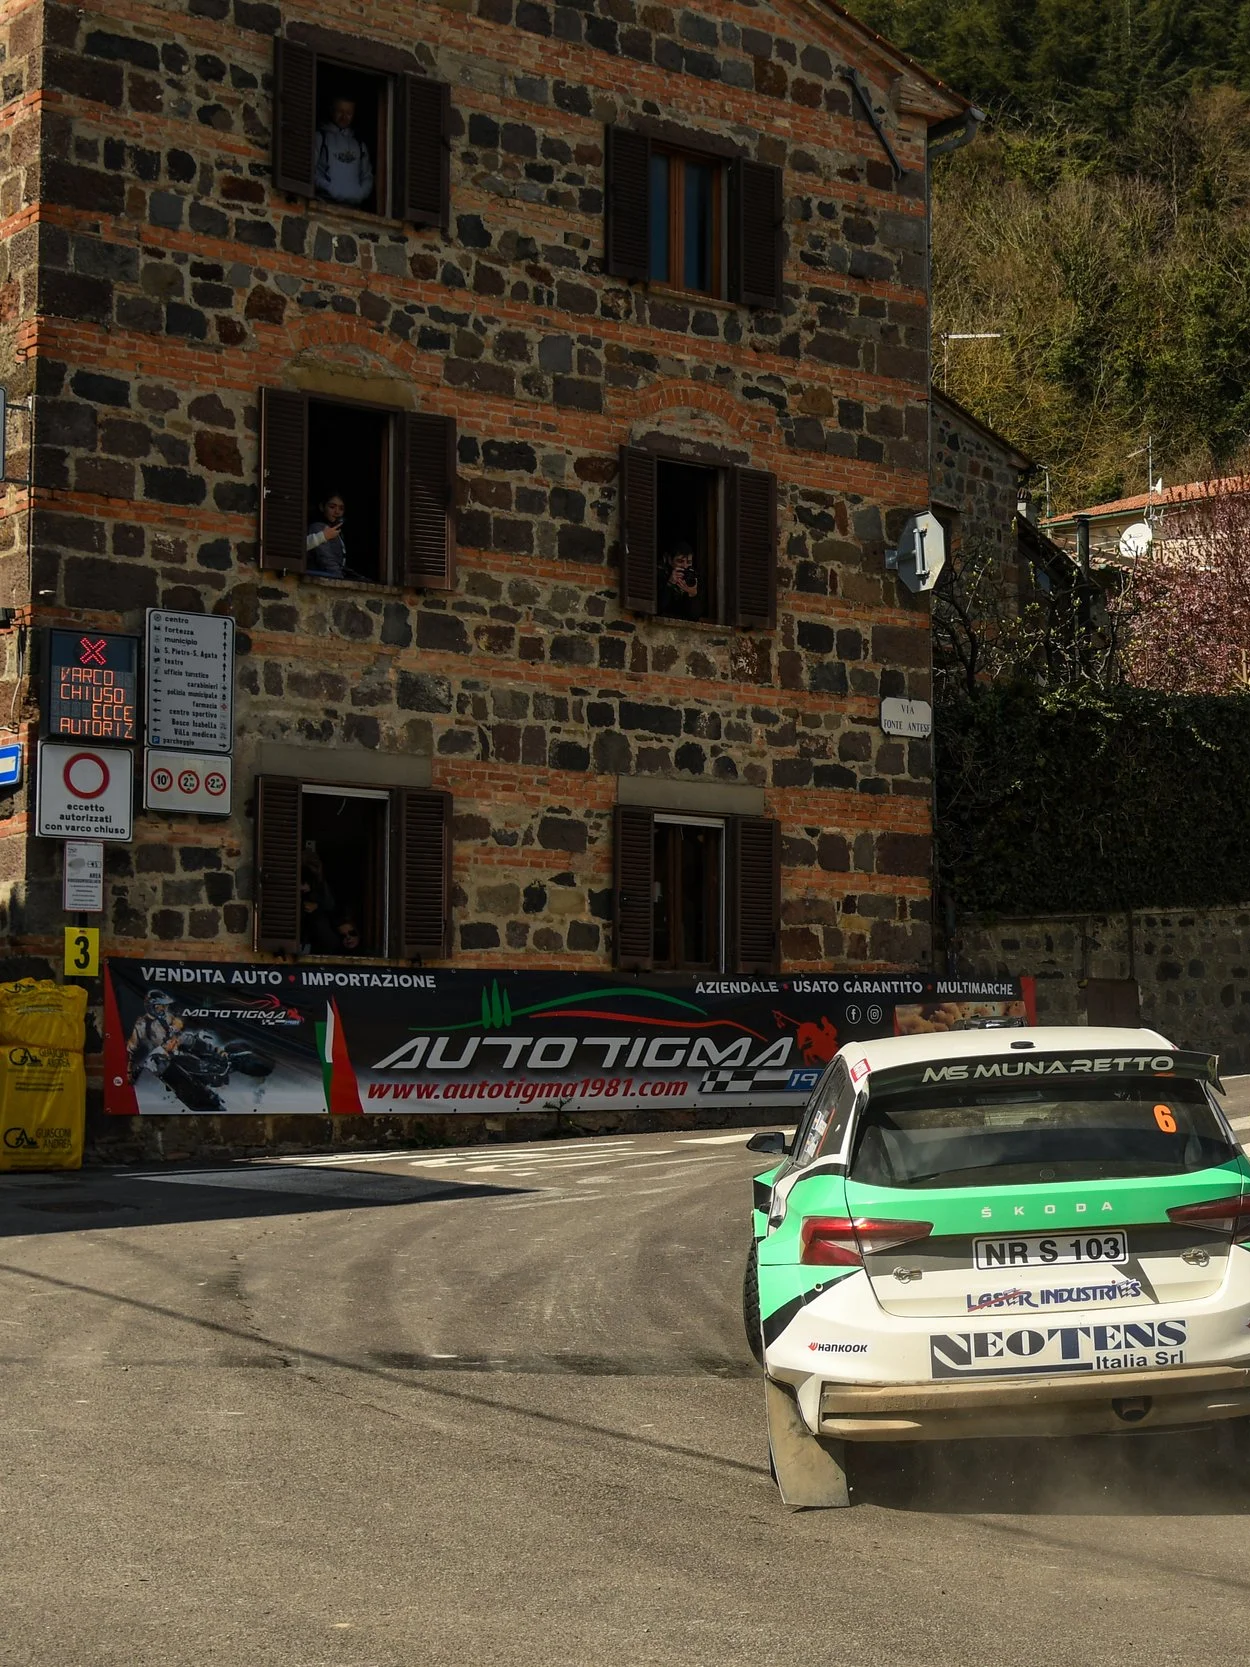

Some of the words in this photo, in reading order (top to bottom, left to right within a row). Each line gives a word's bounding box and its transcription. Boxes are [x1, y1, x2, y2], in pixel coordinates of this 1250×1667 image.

[164, 616, 189, 624] centro
[164, 626, 195, 636] fortezza
[164, 637, 198, 646] municipio
[164, 658, 184, 666] teatro
[61, 667, 114, 686] VARCO
[187, 682, 218, 690] carabinieri
[60, 683, 124, 704] CHIUSO
[92, 703, 133, 722] ECCE
[901, 704, 915, 715] VIA
[60, 717, 133, 739] AUTORIZ
[884, 719, 903, 730] FONTE
[67, 803, 105, 812] eccetto
[59, 814, 112, 823] autorizzati
[45, 823, 63, 831] con
[65, 825, 92, 833] varco
[94, 825, 126, 835] chiuso
[74, 936, 90, 969] 3
[140, 966, 226, 984] VENDITA
[231, 969, 283, 986] AUTO
[302, 971, 436, 989] IMPORTAZIONE
[695, 981, 779, 995] AZIENDALE
[792, 981, 839, 994] USATO
[843, 981, 923, 995] GARANTITO
[936, 981, 1014, 996] MULTIMARCHE
[922, 1065, 969, 1083] MS
[973, 1055, 1174, 1079] MUNARETTO
[368, 1077, 689, 1105] www.autotigma1981.com
[1153, 1103, 1177, 1133] 6
[981, 1201, 1113, 1218] ŠKODA
[985, 1242, 1028, 1266] NR
[1039, 1240, 1059, 1263] S
[1070, 1237, 1120, 1261] 103
[967, 1288, 1039, 1312] LASER
[1040, 1279, 1142, 1305] INDUSTRIES
[930, 1319, 1187, 1378] NEOTENS
[1096, 1351, 1148, 1370] Italia
[1155, 1350, 1184, 1365] Srl
